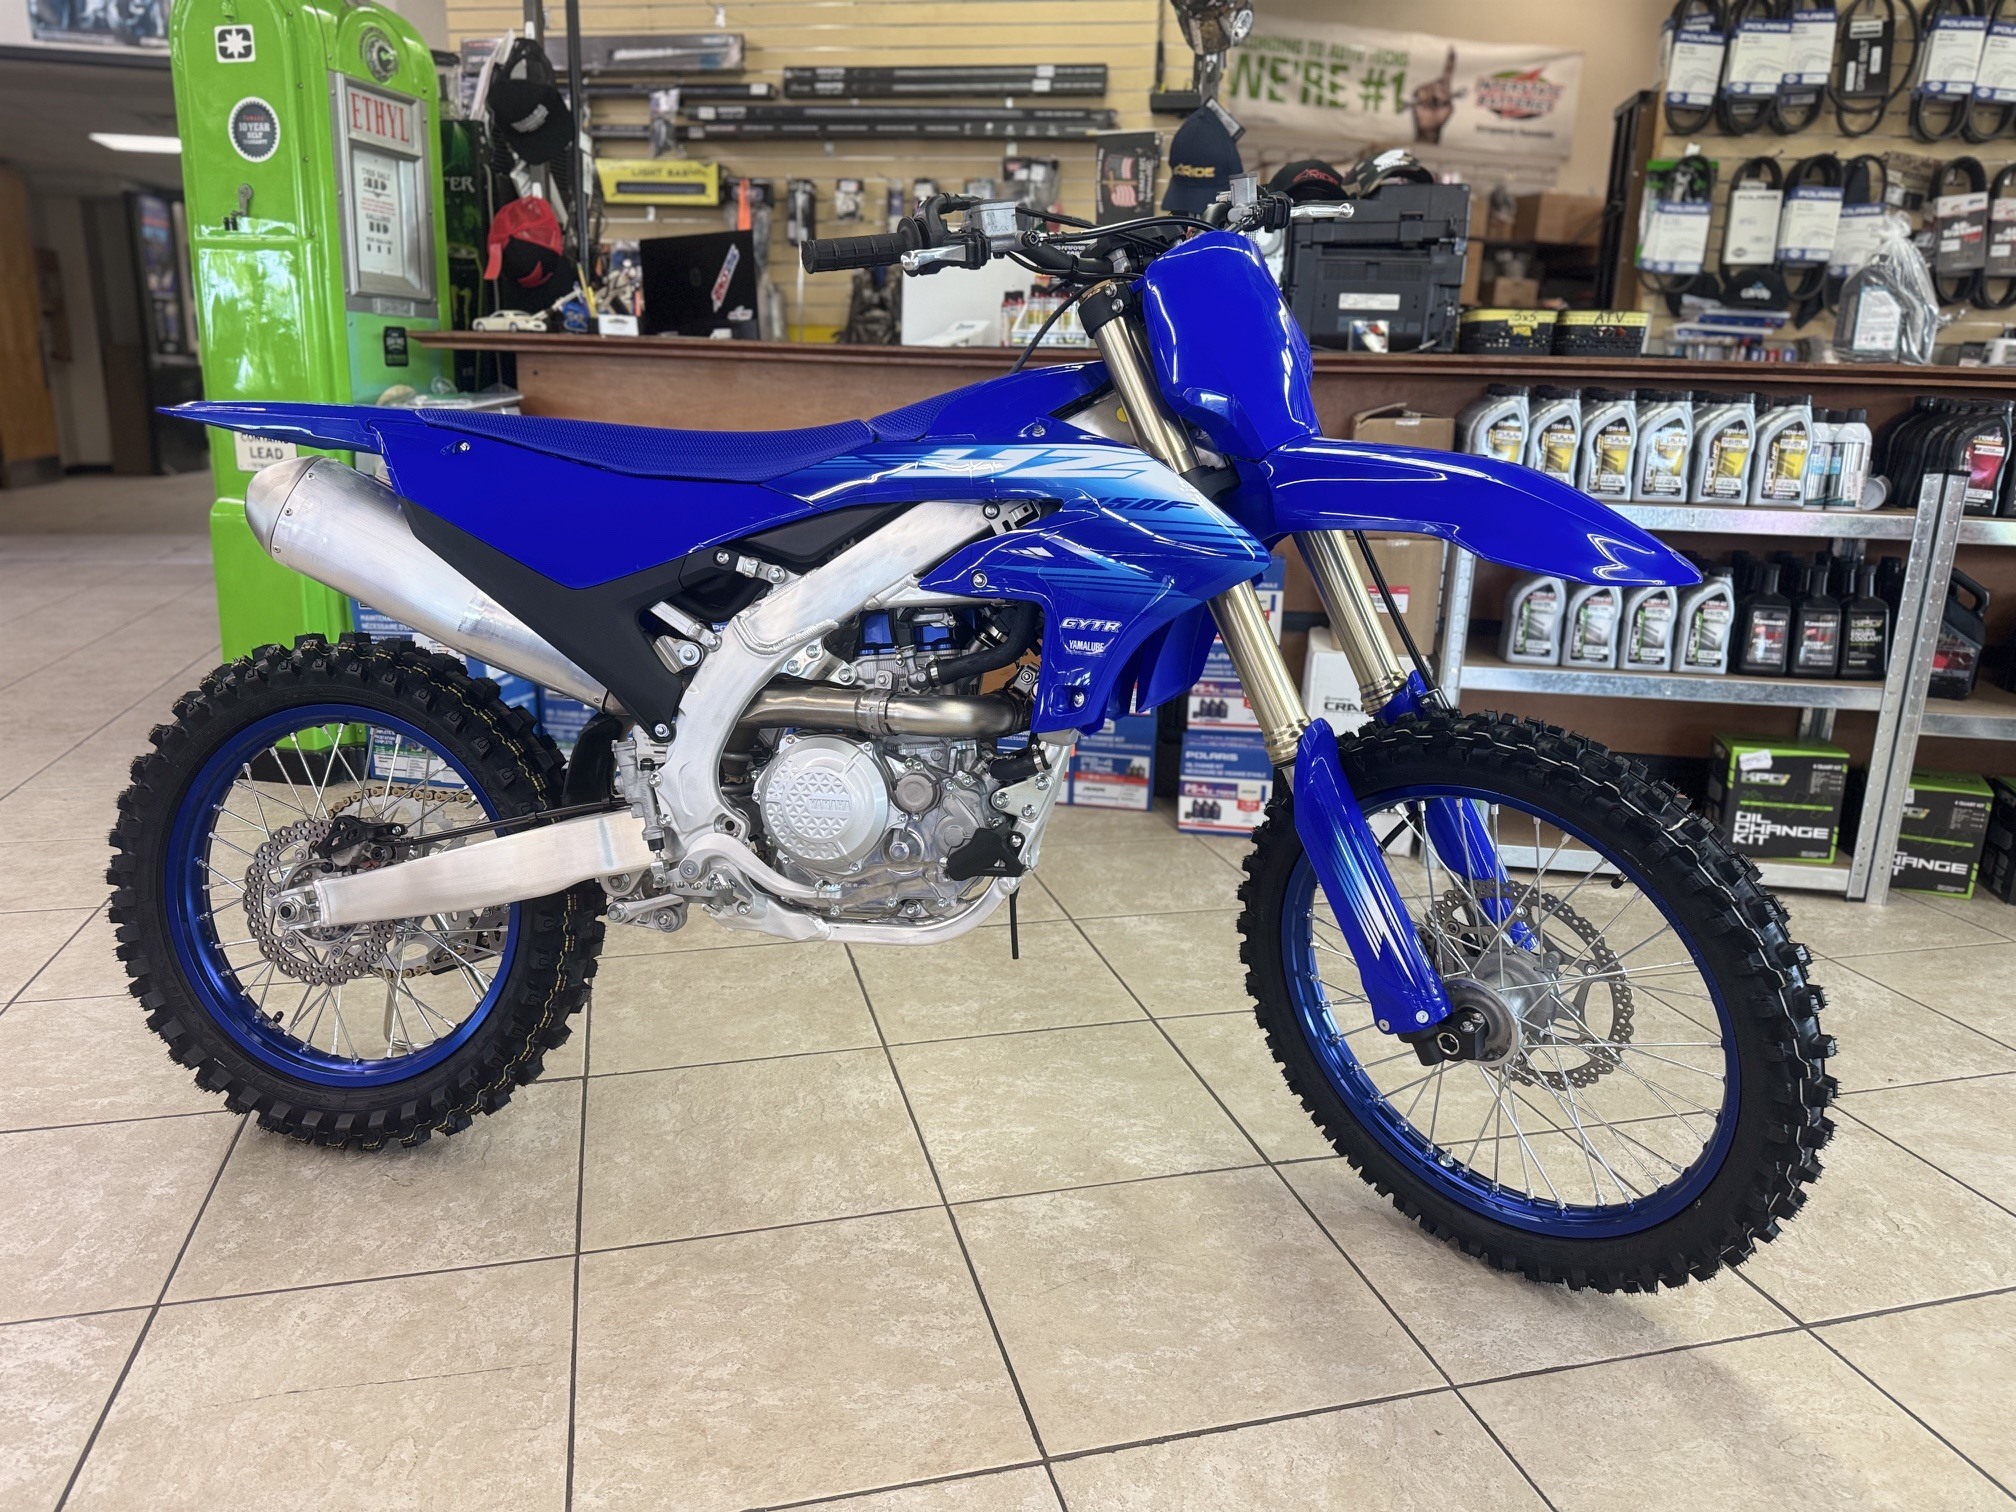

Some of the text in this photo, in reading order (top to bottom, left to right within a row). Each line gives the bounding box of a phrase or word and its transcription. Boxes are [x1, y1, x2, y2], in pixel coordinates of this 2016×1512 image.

[1744, 22, 1790, 32] POLARIS
[1940, 19, 1985, 29] POLARIS
[1680, 33, 1724, 44] POLARIS
[1230, 52, 1407, 115] WE'RE #1
[351, 92, 410, 143] ETHYL
[248, 122, 270, 132] YEAR
[631, 168, 662, 178] LIGHT
[1798, 189, 1842, 200] POLARIS
[1662, 203, 1709, 214] POLARIS
[1594, 311, 1627, 325] ATV
[249, 446, 284, 460] LEAD
[1060, 617, 1122, 633] GYTR
[1754, 618, 1786, 627] Kawasaki
[1804, 620, 1837, 628] Kawasaki
[1068, 640, 1105, 652] YAMALUBE
[1185, 750, 1239, 762] POLARIS
[810, 798, 851, 813] YAMAHA
[1735, 810, 1772, 824] OIL
[1734, 822, 1830, 839] CHANGE
[1732, 833, 1770, 846] KIT
[1894, 855, 1969, 876] ANGE
